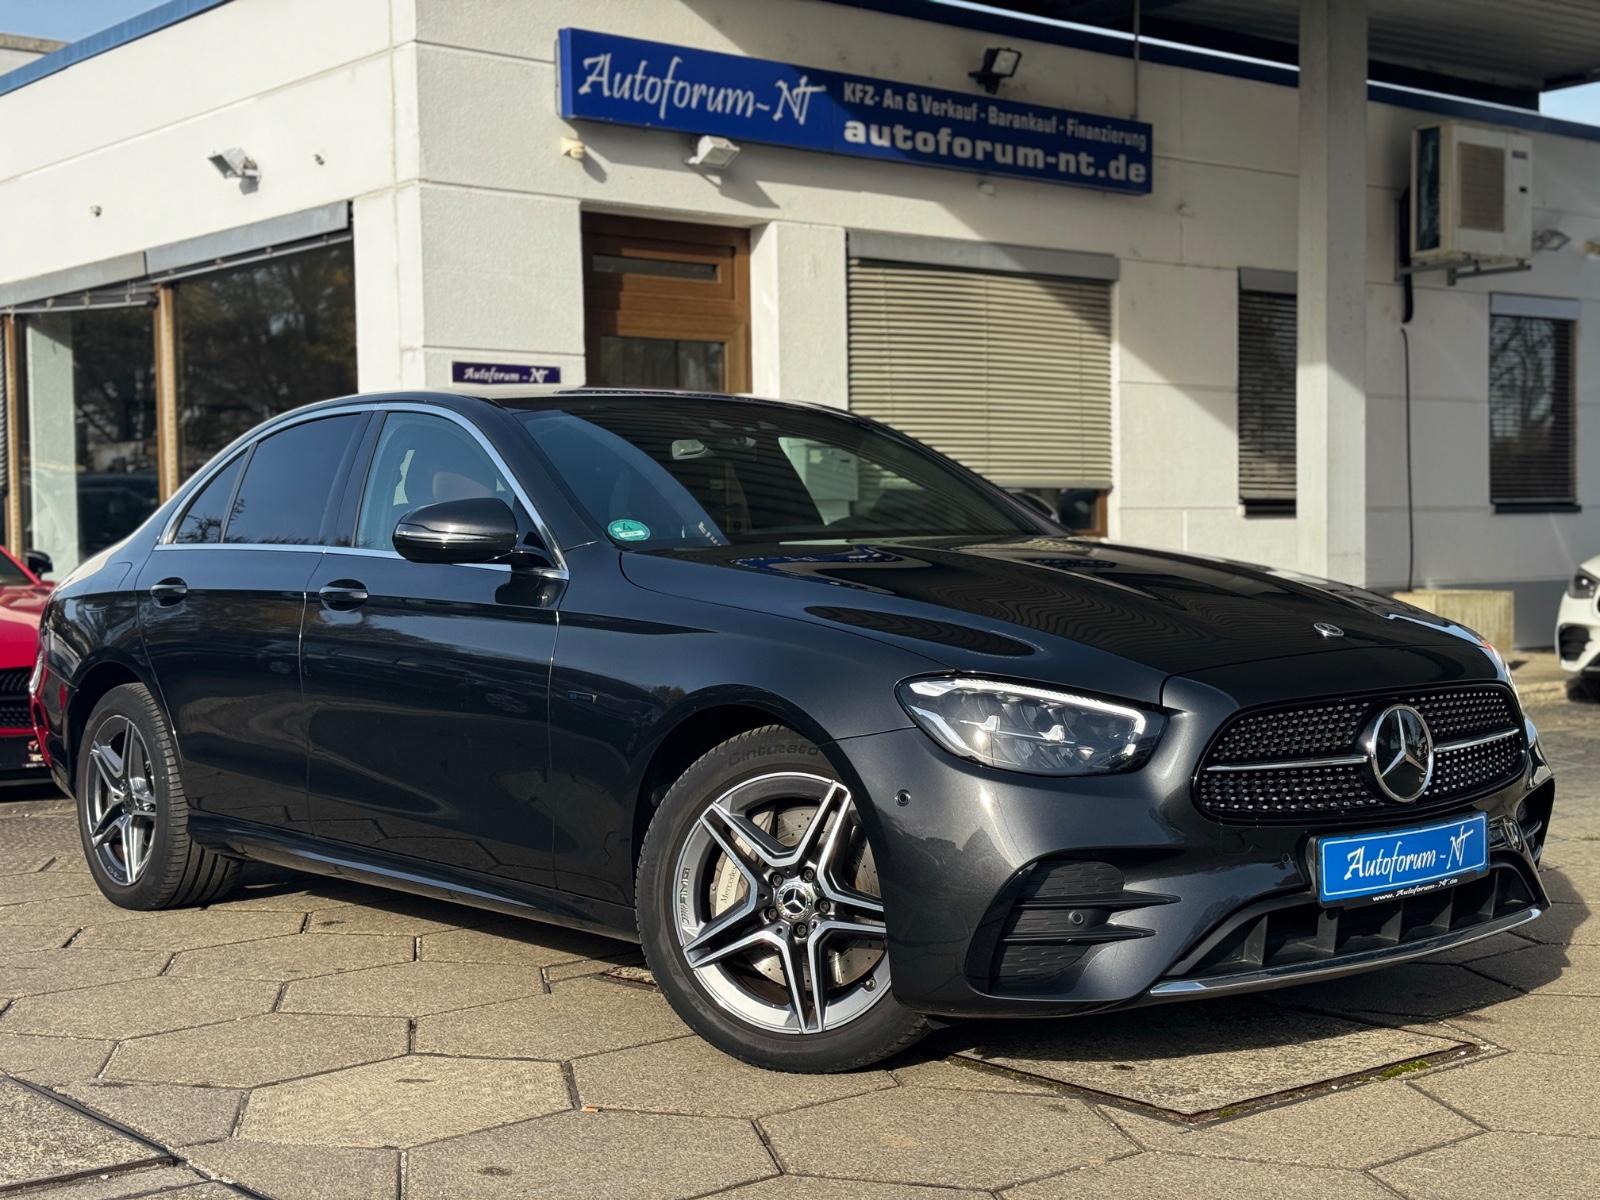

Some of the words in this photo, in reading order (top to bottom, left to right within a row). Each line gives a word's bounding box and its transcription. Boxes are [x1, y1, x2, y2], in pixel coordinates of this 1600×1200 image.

[578, 53, 827, 125] Autoforum-NT
[843, 81, 880, 106] KFZ-
[882, 88, 903, 110] An
[906, 92, 918, 112] &
[921, 94, 978, 122] Verkauf
[988, 105, 1058, 134] Barankauf
[1066, 118, 1147, 152] Finanzierung
[843, 119, 1147, 183] autoforum-nt.de
[463, 366, 521, 383] Autoforum
[1344, 841, 1436, 883] Autoforum
[1446, 825, 1474, 870] NT
